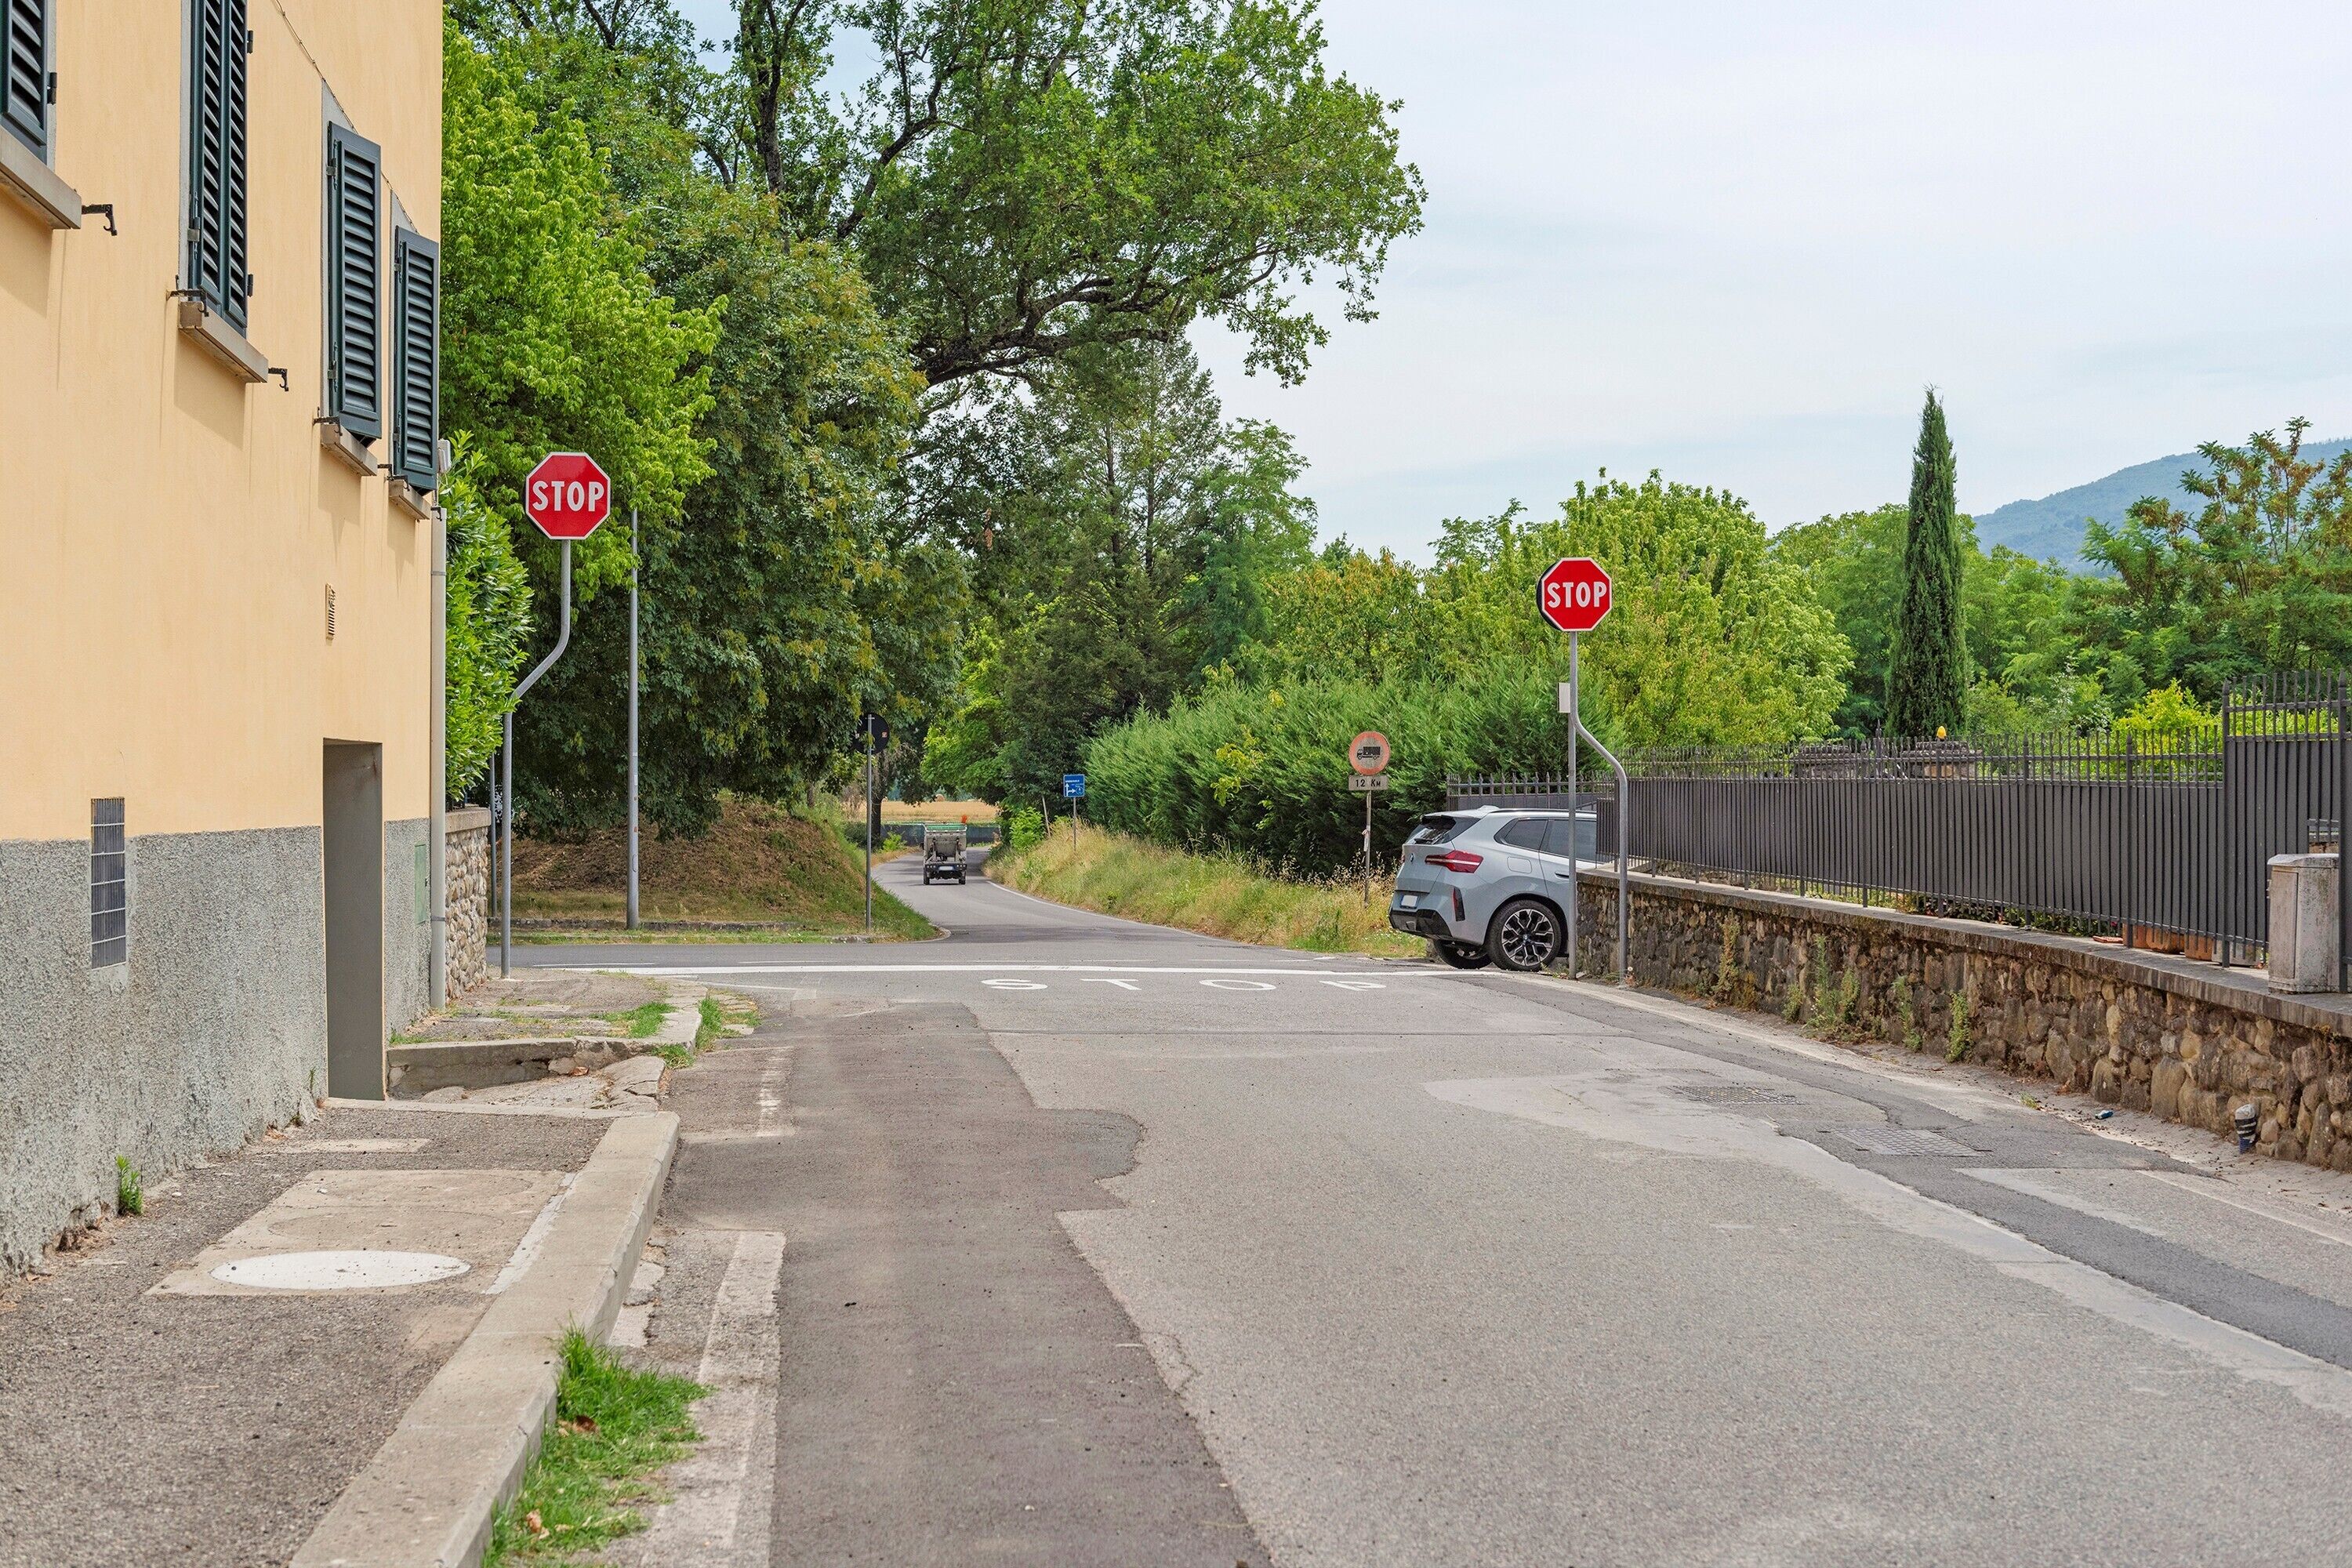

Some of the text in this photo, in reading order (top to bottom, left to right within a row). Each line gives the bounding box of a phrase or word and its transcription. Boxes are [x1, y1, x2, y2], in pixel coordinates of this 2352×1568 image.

[532, 481, 605, 511] STOP
[1548, 582, 1607, 608] STOP
[981, 978, 1387, 991] STOP
